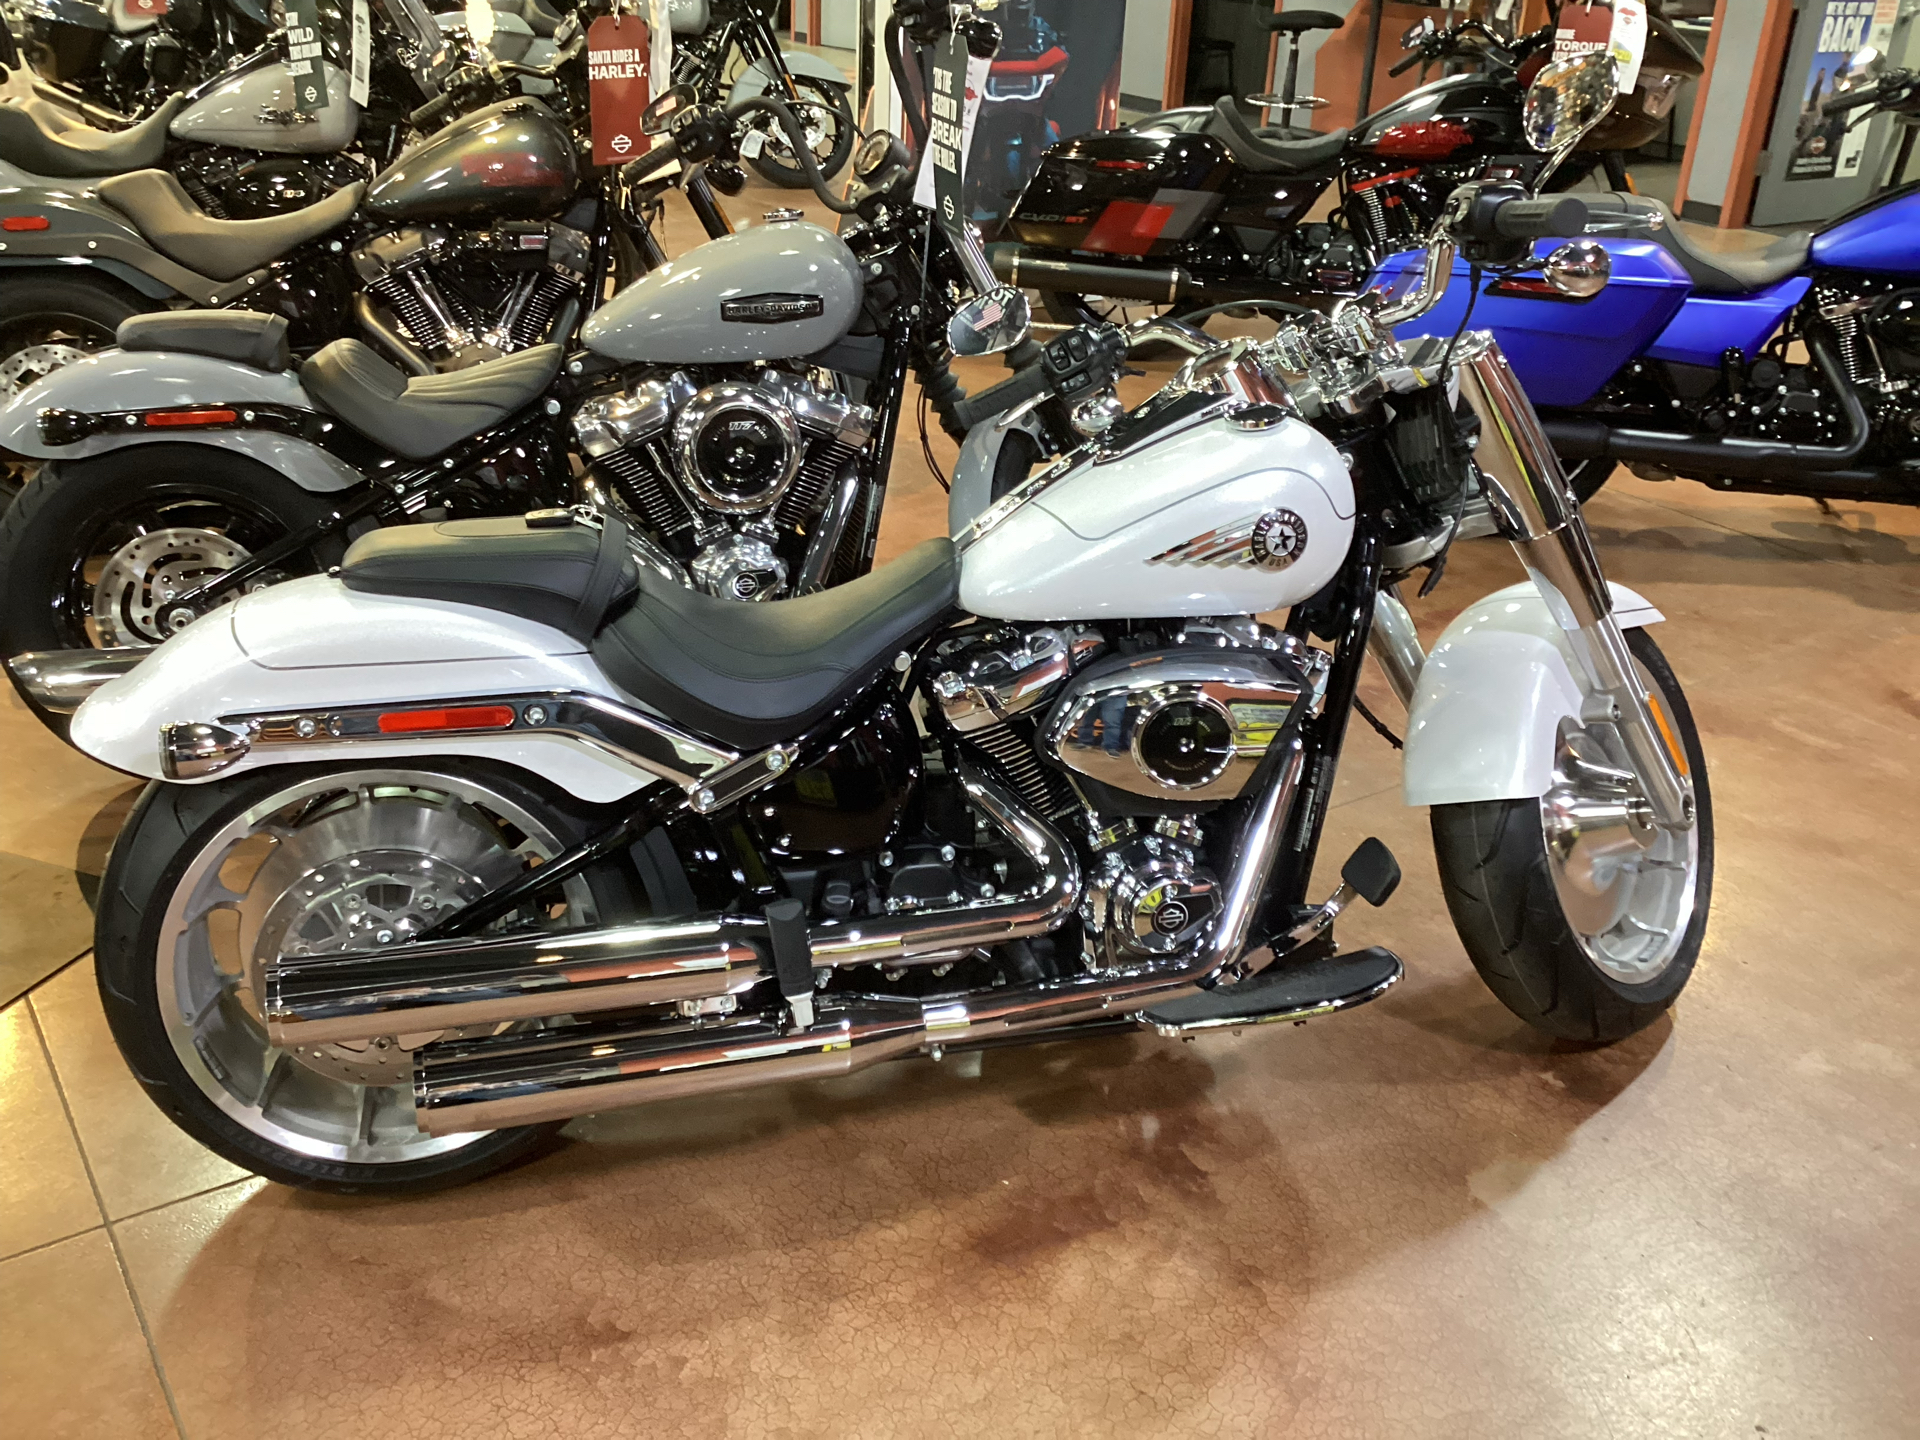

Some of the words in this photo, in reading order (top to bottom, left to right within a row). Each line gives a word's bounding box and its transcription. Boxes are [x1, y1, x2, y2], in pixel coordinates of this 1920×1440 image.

[287, 27, 314, 44] WILD
[1555, 41, 1607, 52] TORQUE
[588, 50, 612, 65] SANTA
[612, 49, 634, 63] RIDES
[634, 48, 641, 62] A
[588, 63, 648, 80] HARLEY.
[931, 117, 962, 152] BREAK
[728, 420, 757, 431] 117
[1268, 557, 1289, 567] USA
